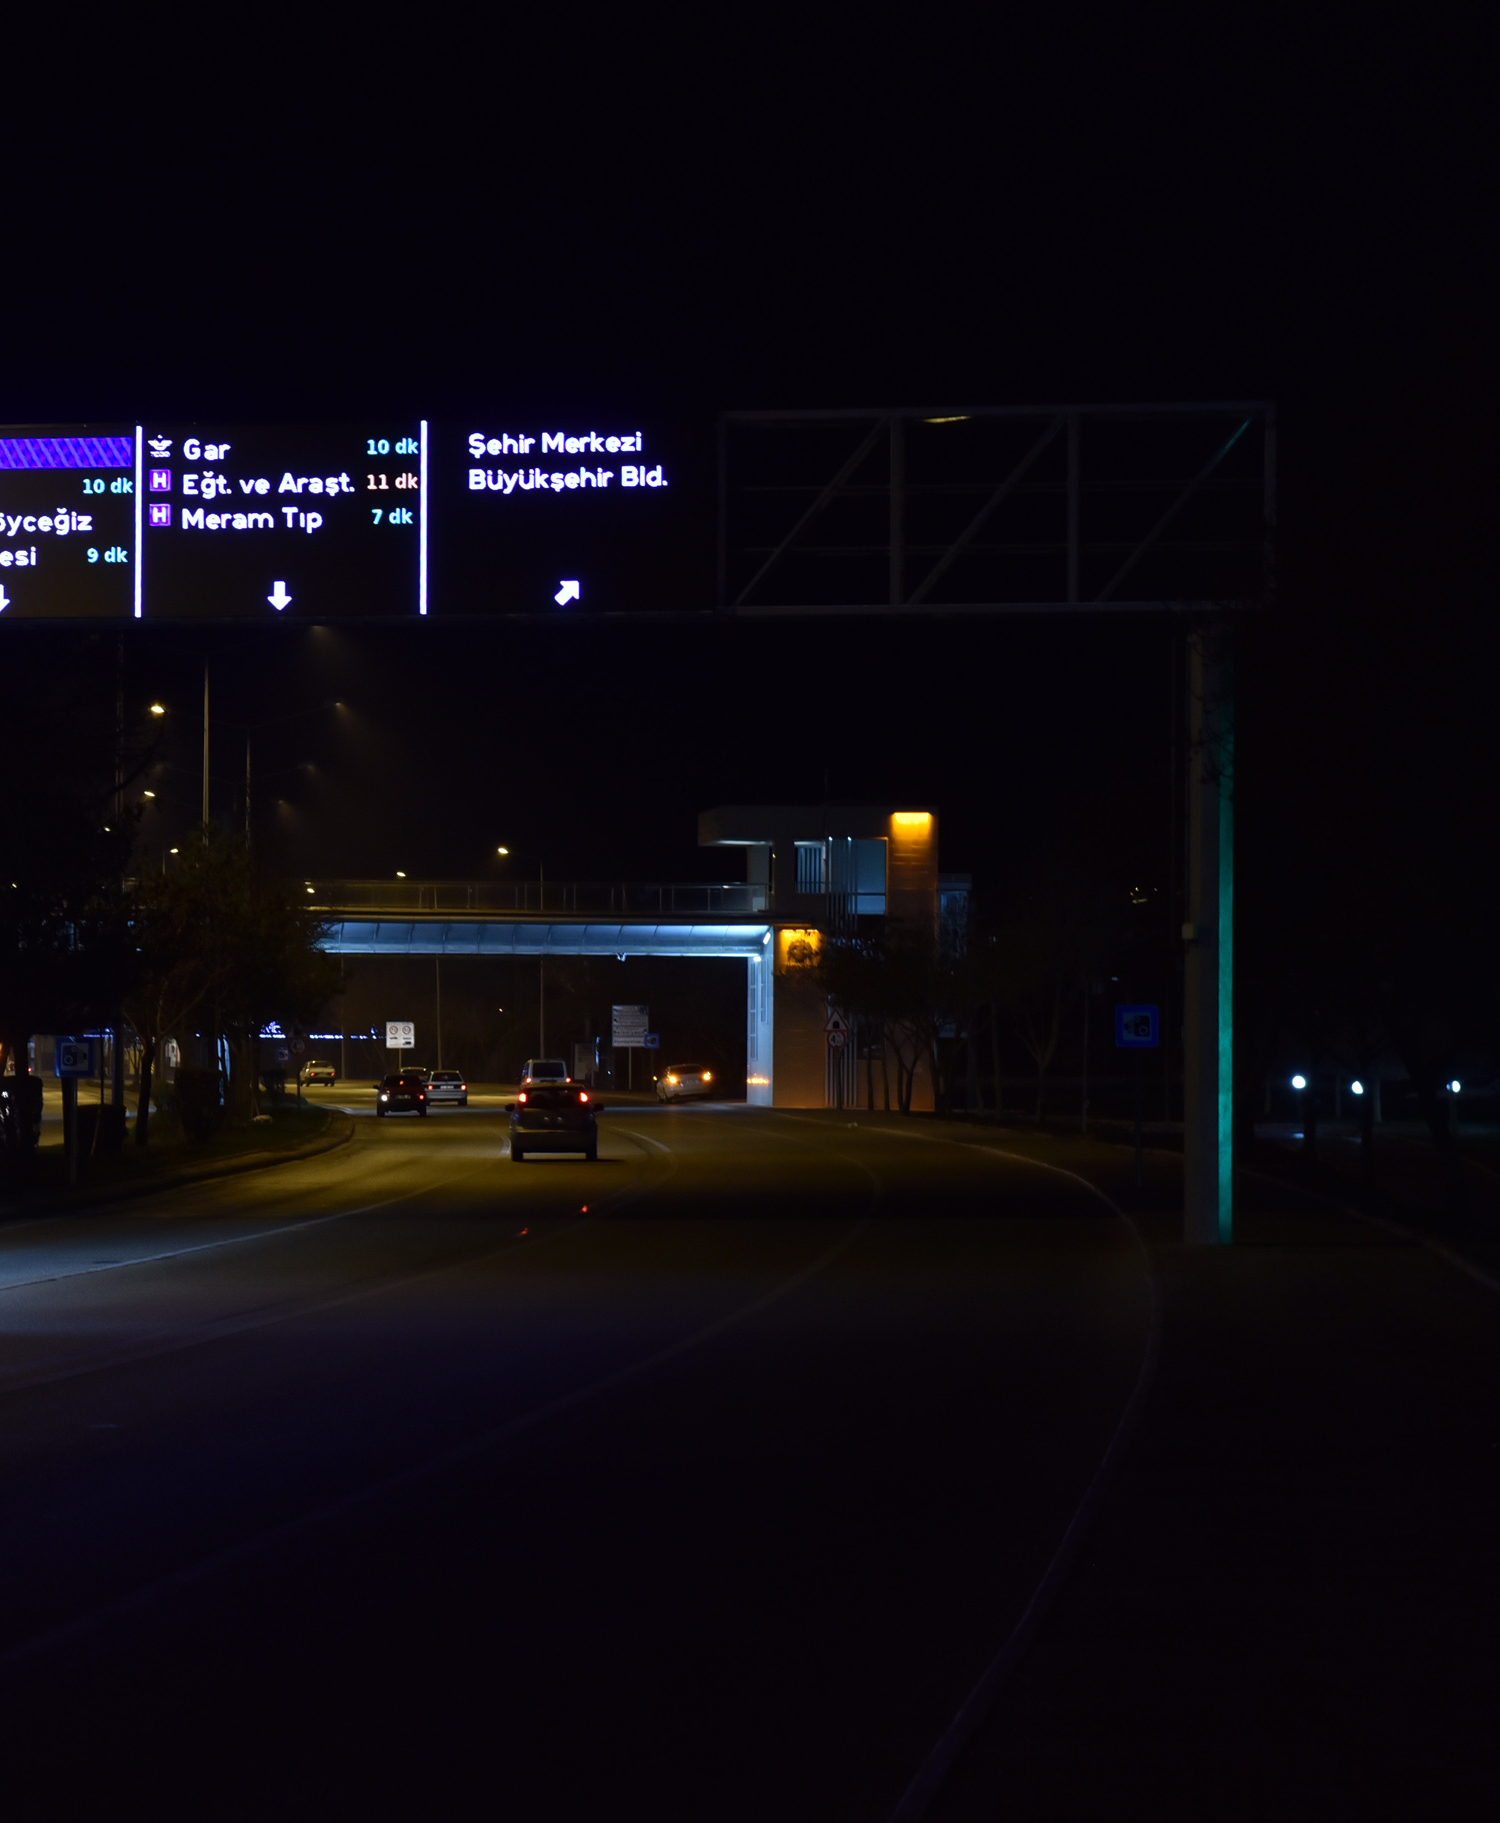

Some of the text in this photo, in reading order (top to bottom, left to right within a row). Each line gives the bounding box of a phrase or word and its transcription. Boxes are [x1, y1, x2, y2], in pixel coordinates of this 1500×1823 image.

[183, 437, 419, 461] Gar 10 dk
[468, 431, 642, 459] Şehir Merkezi
[82, 478, 106, 495] 10
[110, 477, 134, 494] dk
[182, 470, 419, 500] Eğt. ve Araşt. 11 dk
[468, 464, 668, 495] Büyükşehir Bld.
[181, 506, 414, 534] Meram Tıp 7 dk
[86, 547, 99, 564] 9
[103, 546, 129, 563] dk
